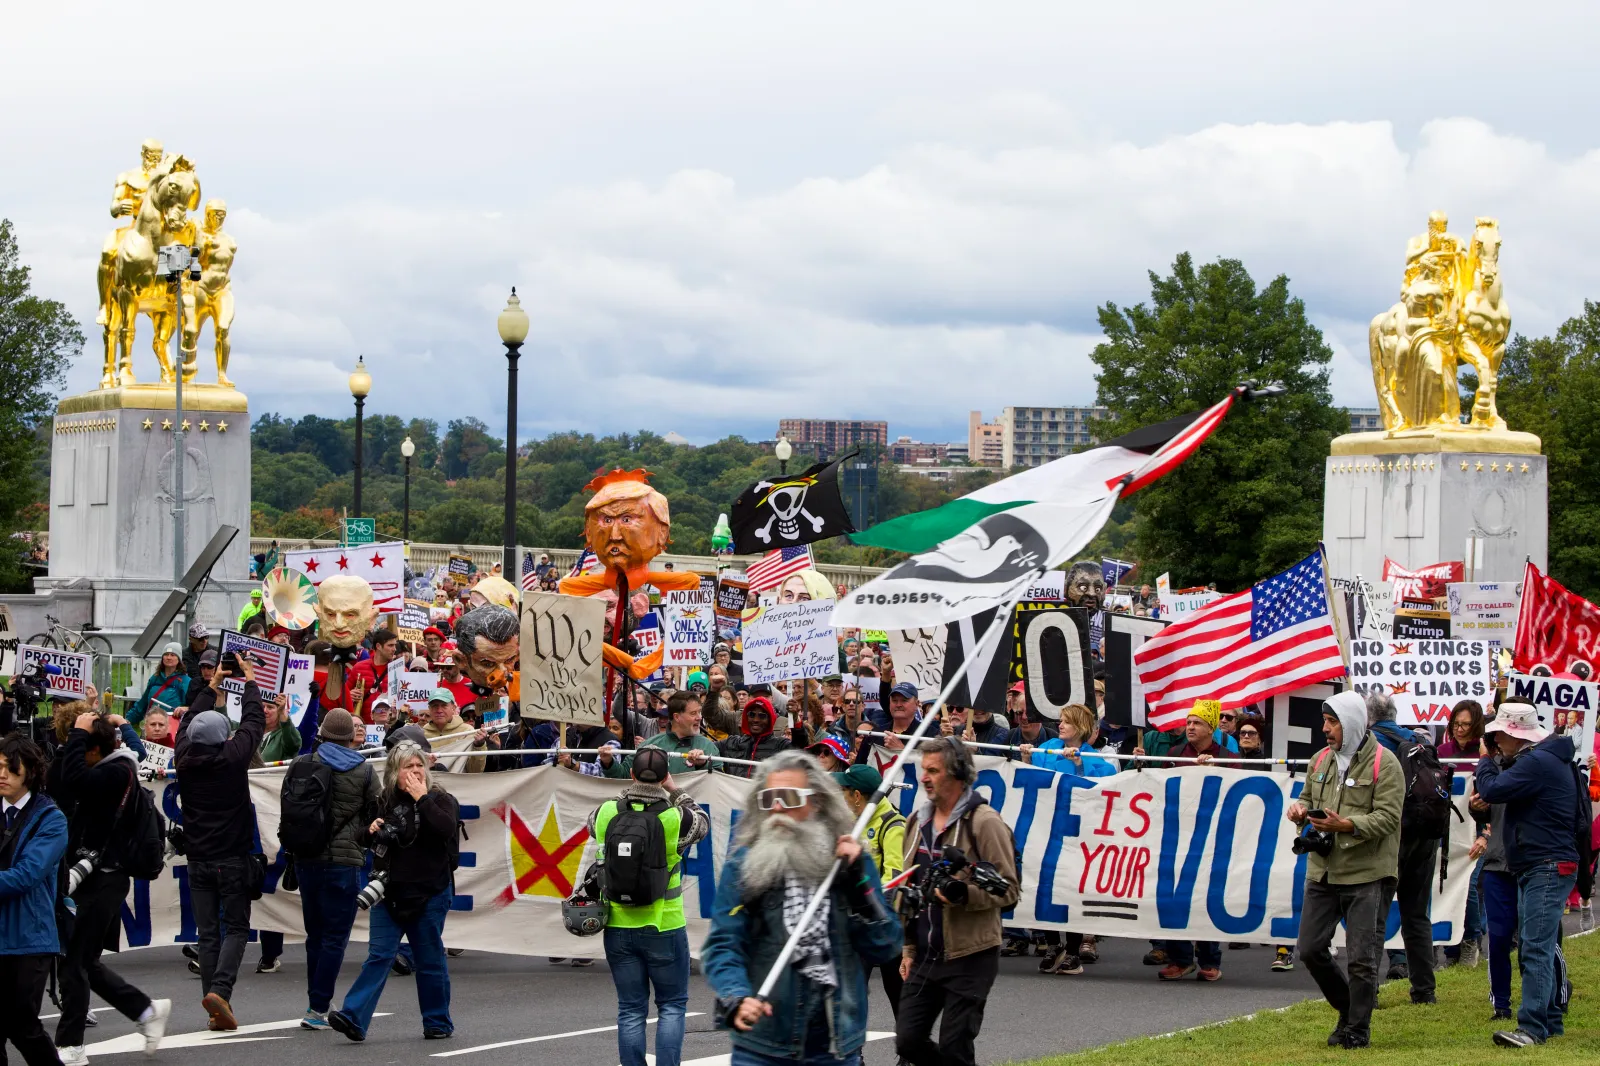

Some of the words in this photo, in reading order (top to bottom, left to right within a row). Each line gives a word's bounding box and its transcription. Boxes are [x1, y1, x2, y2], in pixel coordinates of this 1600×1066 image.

[1435, 565, 1452, 579] THE
[670, 592, 686, 605] NO
[687, 591, 712, 604] KINGS
[720, 591, 745, 600] ILLEGAL
[1034, 588, 1060, 598] EARLY
[1175, 601, 1186, 613] I'D
[1403, 602, 1432, 610] TRUMP
[399, 614, 430, 625] Fascist
[403, 609, 427, 618] rump
[675, 619, 702, 631] ONLY
[1412, 618, 1429, 626] The
[525, 604, 600, 669] We
[671, 631, 709, 643] VOTERS
[1400, 624, 1444, 639] Trump
[227, 634, 281, 654] PRO-AMERICA
[775, 643, 807, 657] LUFFY
[1353, 641, 1384, 656] NO
[1419, 641, 1484, 656] KINGS
[25, 651, 83, 668] PROTECT
[670, 649, 697, 660] VOTE
[288, 658, 309, 670] VOTE
[802, 663, 832, 678] VOTE
[1353, 661, 1384, 676] NO
[1389, 660, 1482, 676] CROOKS
[59, 666, 80, 678] UR
[288, 674, 295, 684] A
[550, 660, 577, 689] the
[50, 675, 82, 692] VOTE!
[1415, 681, 1485, 696] LIARS
[526, 679, 597, 718] People
[1515, 679, 1590, 709] MAGA
[1094, 790, 1153, 838] IS
[1079, 842, 1150, 898] YOUR
